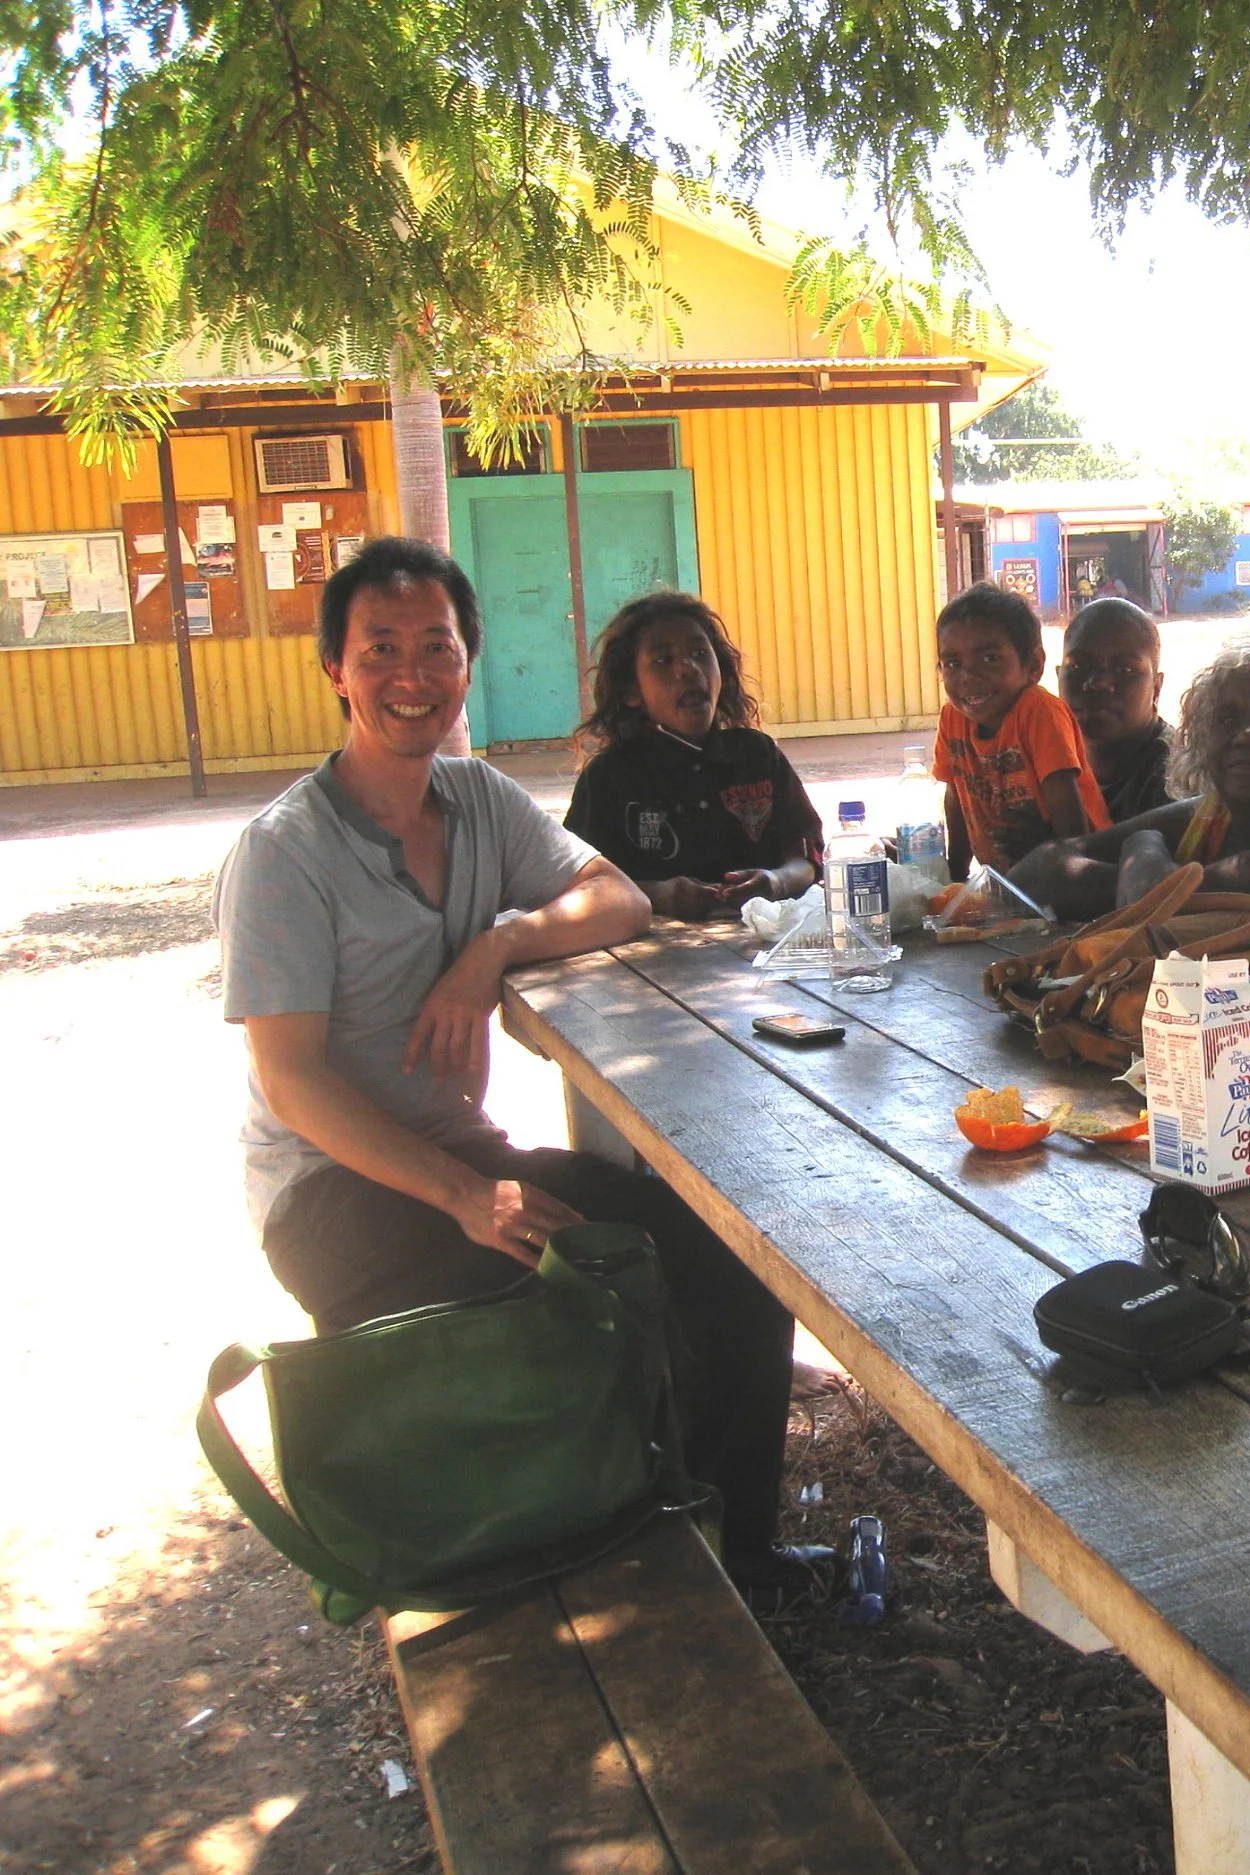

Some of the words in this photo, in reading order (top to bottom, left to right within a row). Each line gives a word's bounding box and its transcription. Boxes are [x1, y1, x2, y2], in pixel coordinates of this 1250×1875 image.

[639, 837, 662, 849] 1872
[1222, 1005, 1241, 1016] Iced
[1121, 1285, 1178, 1310] Canon
